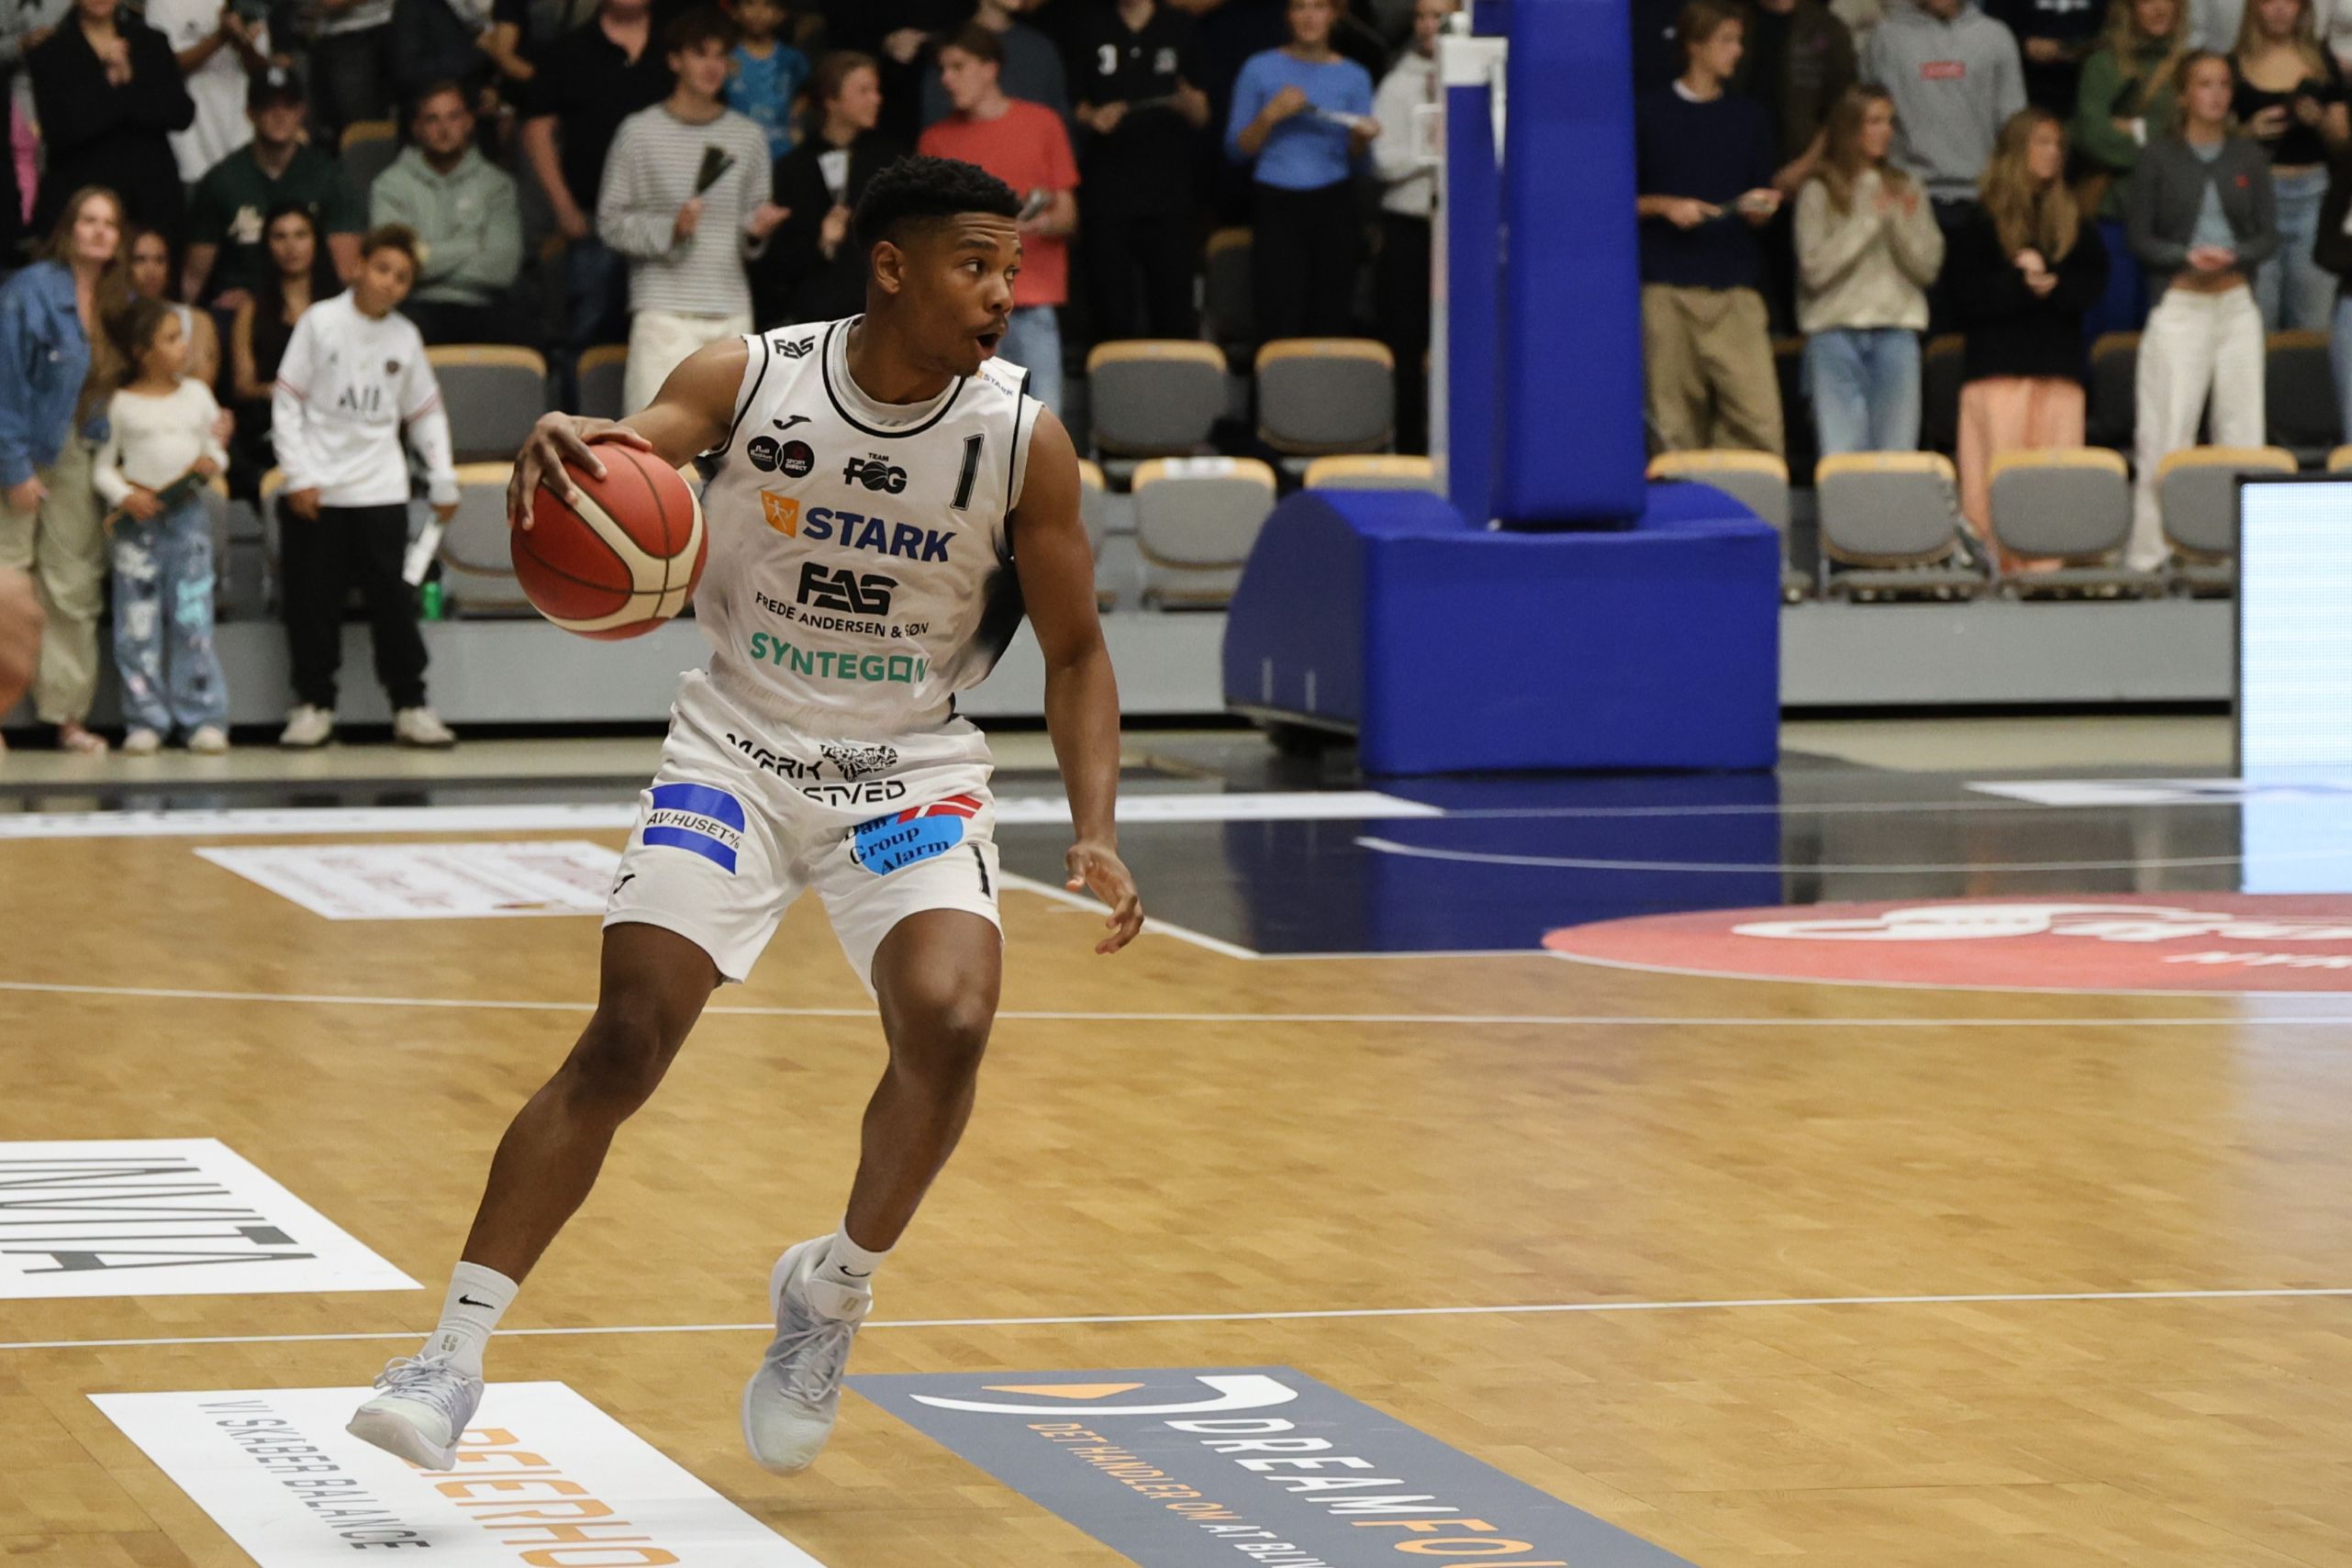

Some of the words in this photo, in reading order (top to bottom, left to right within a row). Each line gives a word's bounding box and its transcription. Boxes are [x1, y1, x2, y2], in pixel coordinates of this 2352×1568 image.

[867, 452, 889, 462] TEAM
[803, 507, 957, 562] STARK
[797, 562, 899, 617] FAS
[755, 592, 797, 620] FREDE
[798, 613, 886, 637] ANDERSEN
[890, 626, 902, 639] &
[850, 827, 920, 864] Group
[882, 840, 950, 875] Alarm
[197, 1400, 273, 1414] VI
[216, 1418, 340, 1473] SKABER
[1027, 1423, 1109, 1444] DET
[1066, 1446, 1202, 1499] HANDLER
[282, 1479, 431, 1550] BALANCE
[1165, 1502, 1243, 1520] OM
[1199, 1524, 1277, 1538] AT
